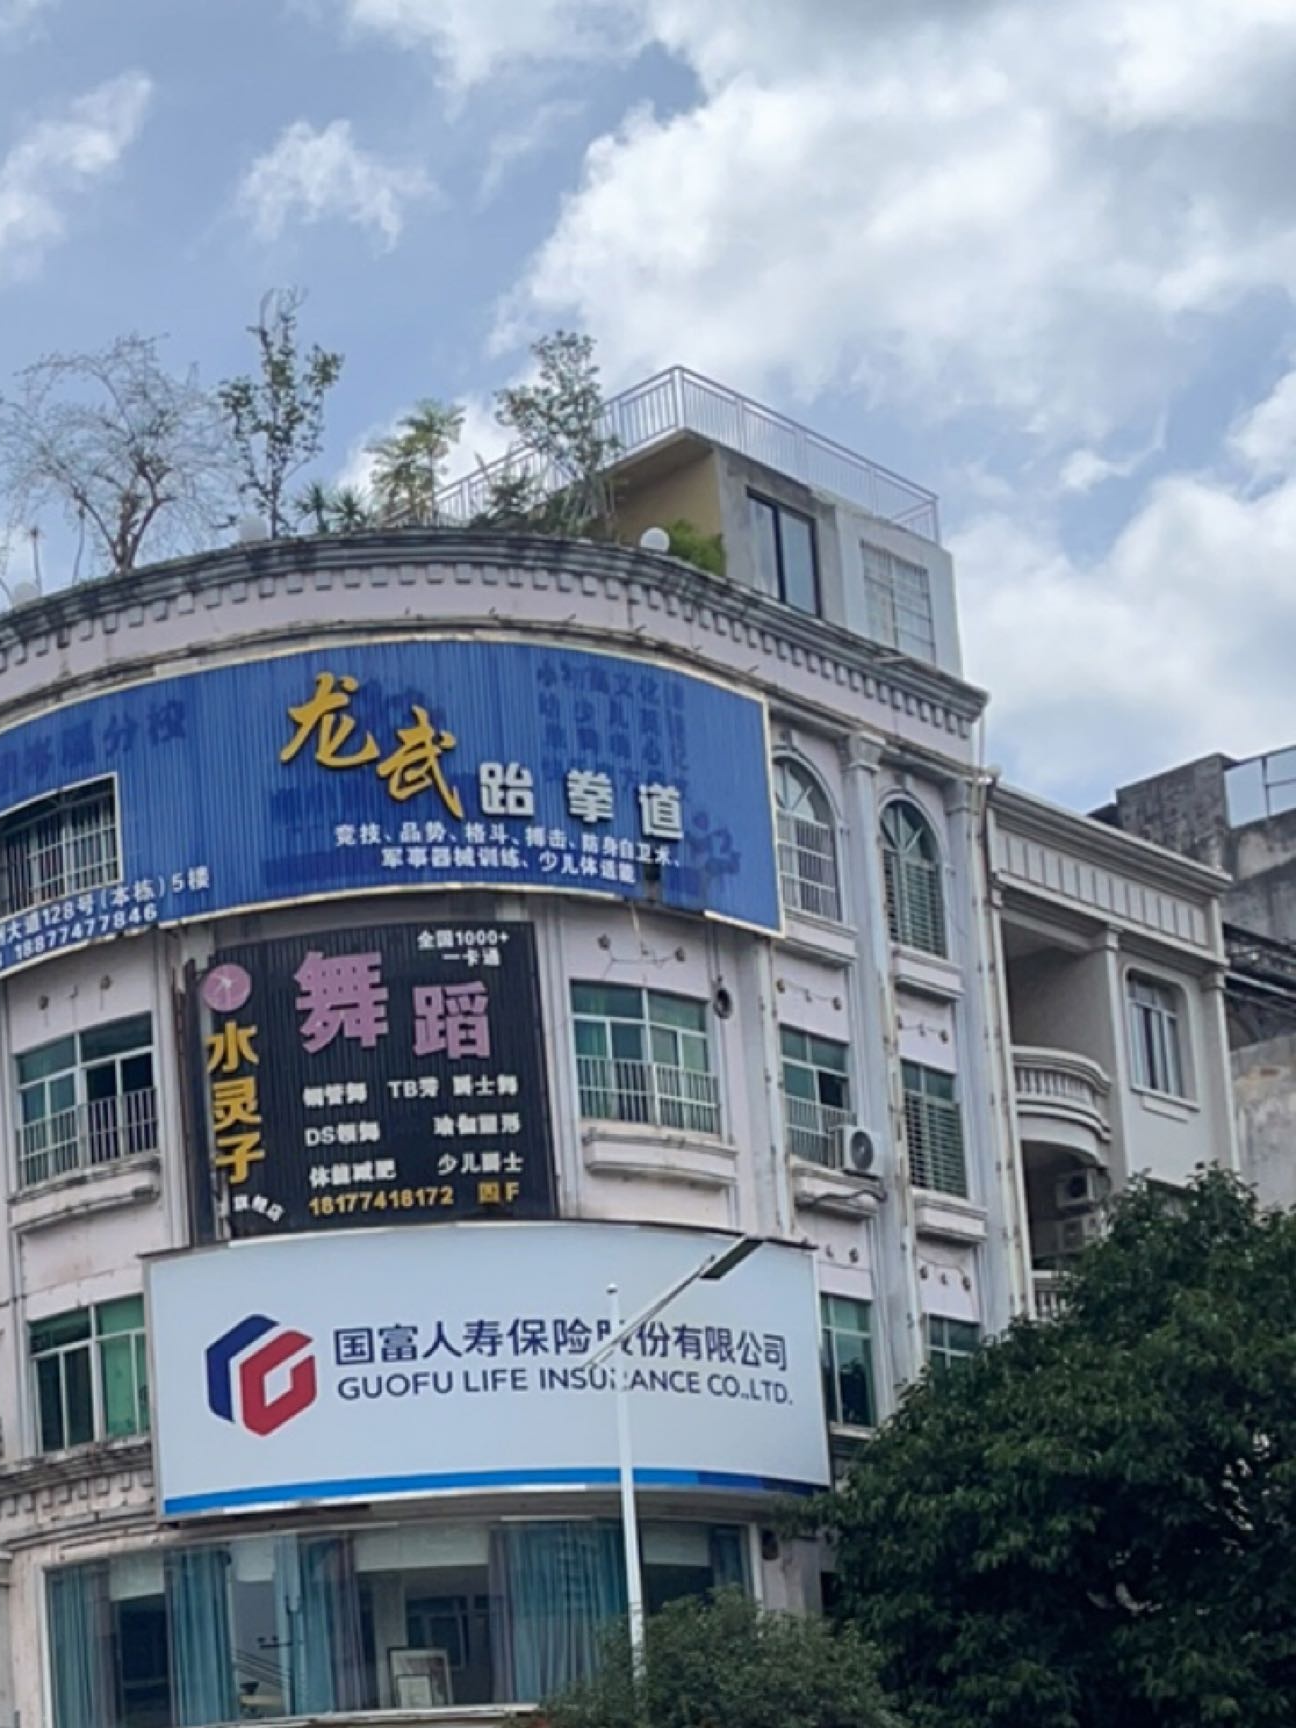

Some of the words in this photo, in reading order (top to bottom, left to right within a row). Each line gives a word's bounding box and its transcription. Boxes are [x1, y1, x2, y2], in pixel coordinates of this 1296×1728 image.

[280, 671, 463, 818] 龙武
[479, 761, 684, 840] 跆拳道
[417, 929, 510, 951] 全国1000+
[442, 947, 502, 967] 一卡通
[293, 950, 491, 1061] 舞蹈
[452, 1073, 519, 1098] 爵士舞
[206, 1020, 266, 1184] 水灵子
[438, 1150, 524, 1176] 少儿爵士
[337, 1370, 455, 1402] GUOFU
[463, 1368, 528, 1393] LIFE
[539, 1367, 702, 1394] INSUANCE
